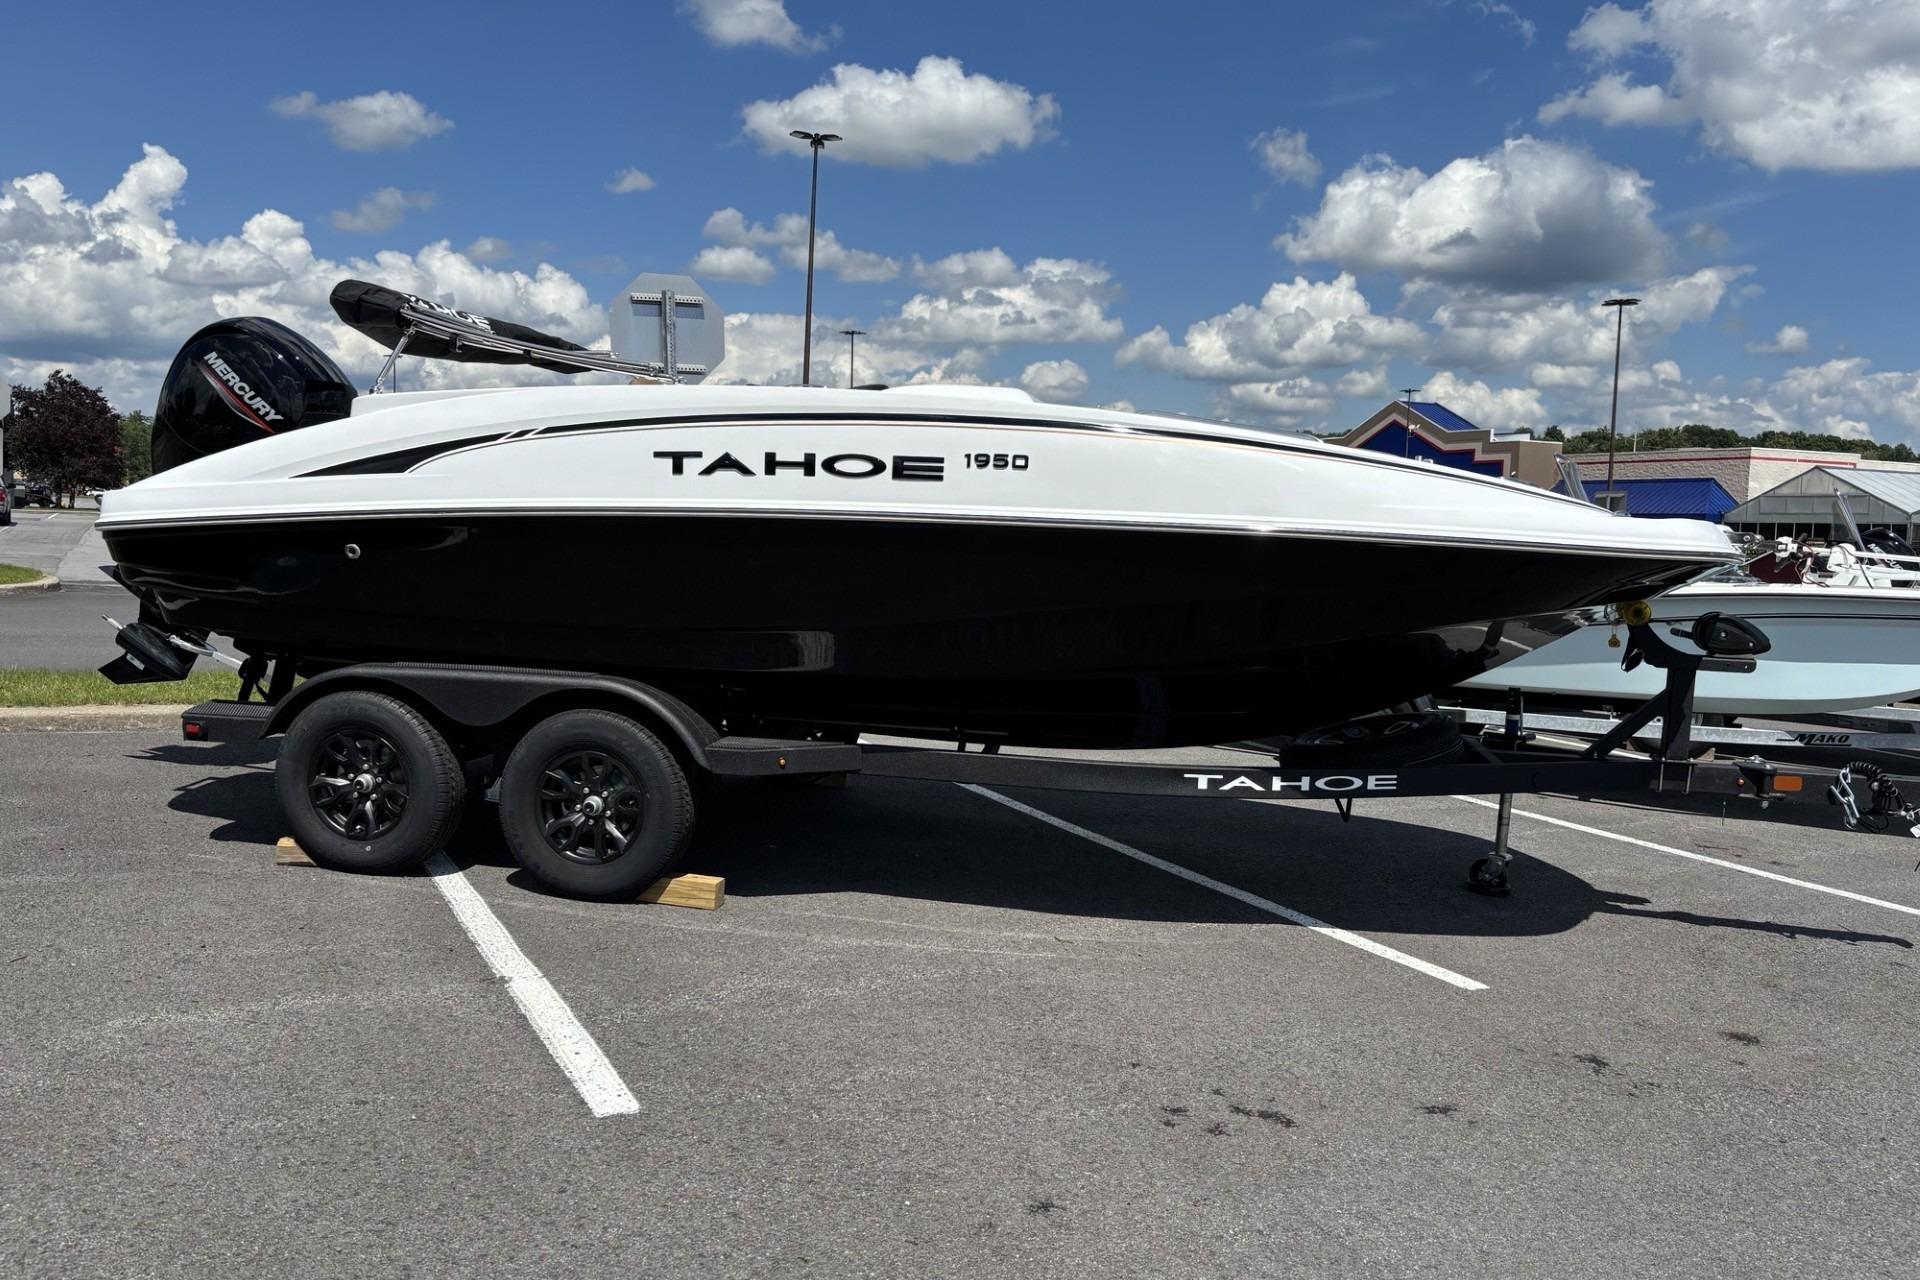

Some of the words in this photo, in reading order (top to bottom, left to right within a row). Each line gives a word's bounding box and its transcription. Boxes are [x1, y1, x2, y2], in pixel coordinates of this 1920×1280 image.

[203, 351, 284, 421] MERCURY
[653, 451, 945, 482] TAHOE
[963, 453, 1029, 471] 1950
[1793, 733, 1851, 747] MAKO
[1184, 773, 1398, 792] TAHOE
